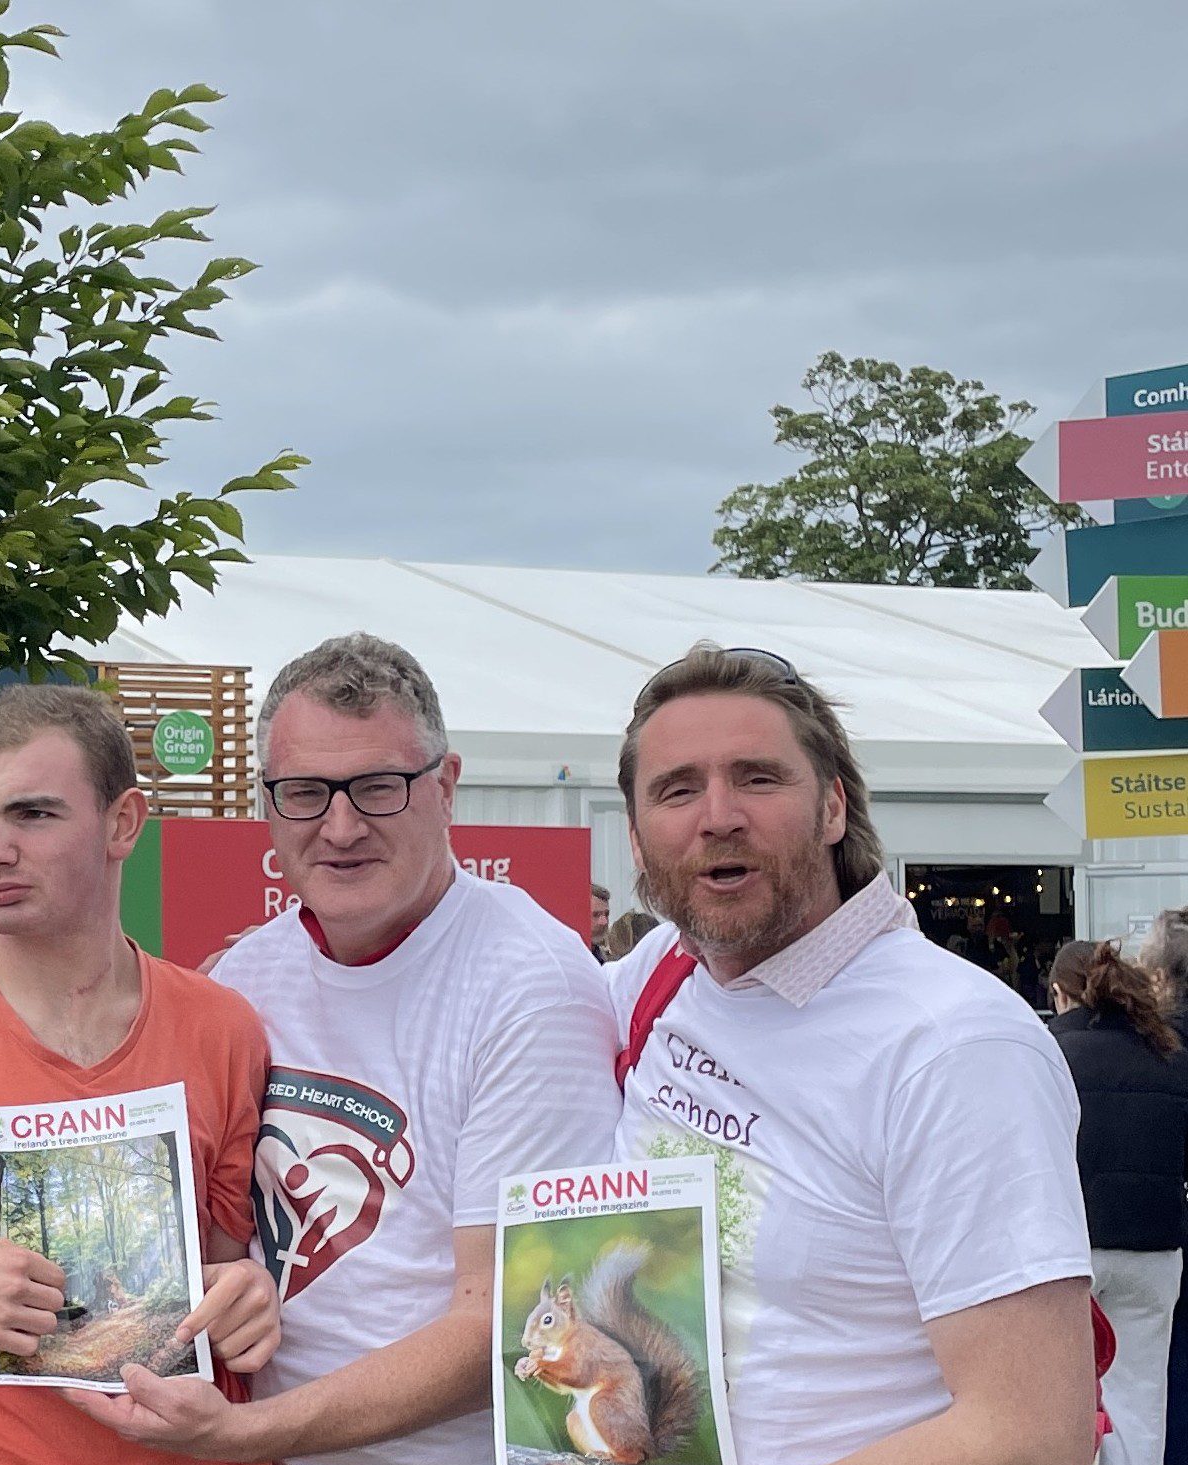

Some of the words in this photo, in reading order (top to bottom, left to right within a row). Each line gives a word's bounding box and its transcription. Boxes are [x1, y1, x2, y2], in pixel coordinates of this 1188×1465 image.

[1134, 382, 1188, 407] Comh
[1135, 599, 1188, 628] Bud
[164, 725, 204, 743] Origin
[164, 740, 204, 754] Green
[1111, 773, 1186, 793] Stáitse
[11, 1103, 126, 1138] CRANN
[14, 1138, 57, 1149] Ireland's
[59, 1137, 78, 1146] tree
[80, 1131, 128, 1145] magazine
[532, 1169, 649, 1207] CRANN
[534, 1206, 576, 1219] Ireland's
[578, 1205, 598, 1215] tree
[600, 1200, 649, 1214] magazine
